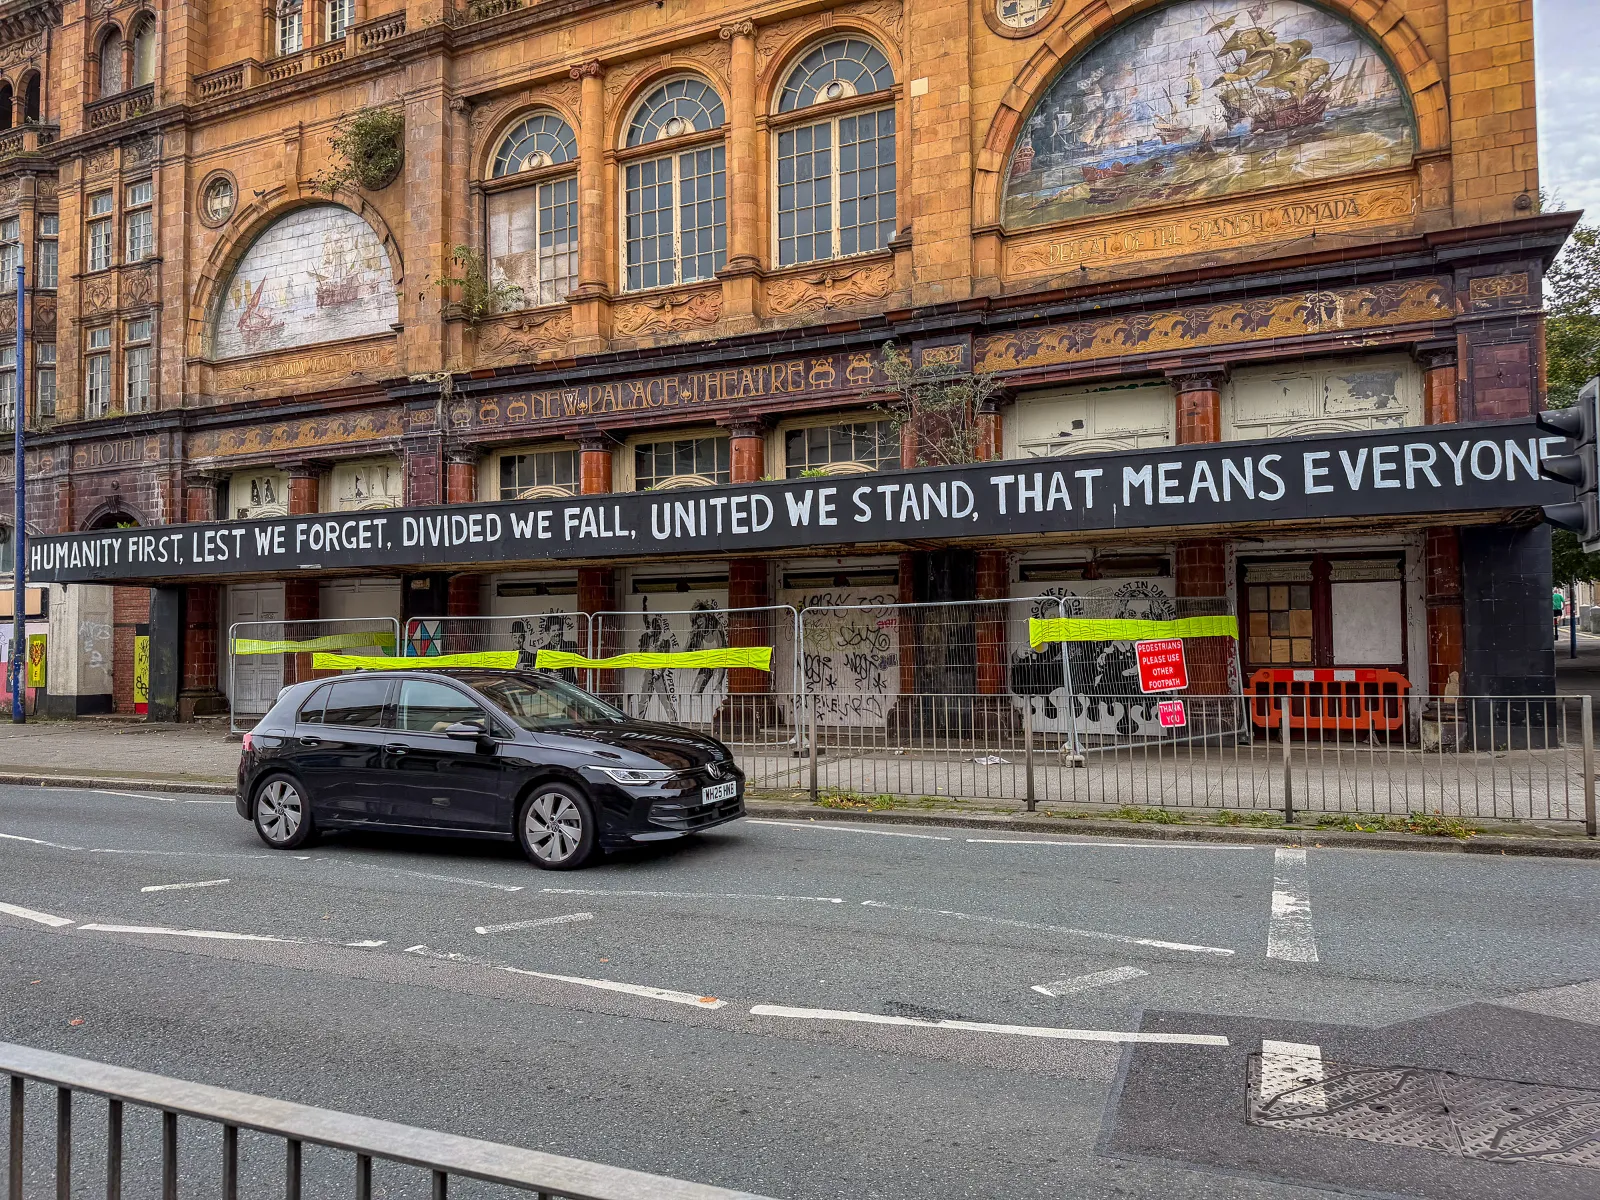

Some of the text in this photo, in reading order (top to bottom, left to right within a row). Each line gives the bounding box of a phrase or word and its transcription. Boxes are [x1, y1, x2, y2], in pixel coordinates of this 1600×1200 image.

[1050, 237, 1110, 263] DEFEAT
[1124, 230, 1144, 251] OF
[1149, 224, 1182, 248] THE
[1190, 213, 1263, 242] SPANISH
[1280, 198, 1361, 226] ARMADA
[531, 360, 805, 419] NEW PALACE THEATRE
[91, 439, 141, 466] HOTEL
[31, 538, 122, 571] HUMANITY
[128, 533, 183, 565] FIRST,
[193, 528, 246, 563] LEST
[254, 525, 286, 556] WE
[296, 518, 392, 553] FORGET,
[402, 513, 501, 547] DIVIDED
[510, 510, 553, 539] WE
[564, 505, 636, 541] FALL,
[651, 494, 774, 540] UNITED
[784, 487, 838, 527] WE
[852, 480, 979, 523] STAND,
[990, 468, 1103, 515] THAT
[1123, 454, 1286, 507] MEANS
[1114, 582, 1133, 598] REST
[1135, 581, 1148, 589] IN
[670, 632, 681, 649] THE
[1138, 641, 1181, 653] PEDESTRIANS
[1142, 653, 1180, 665] PLEASE USE
[1152, 666, 1174, 676] OTHER
[1148, 678, 1181, 689] FOOTPATH
[1160, 703, 1182, 714] THANK
[1166, 715, 1180, 724] YOU
